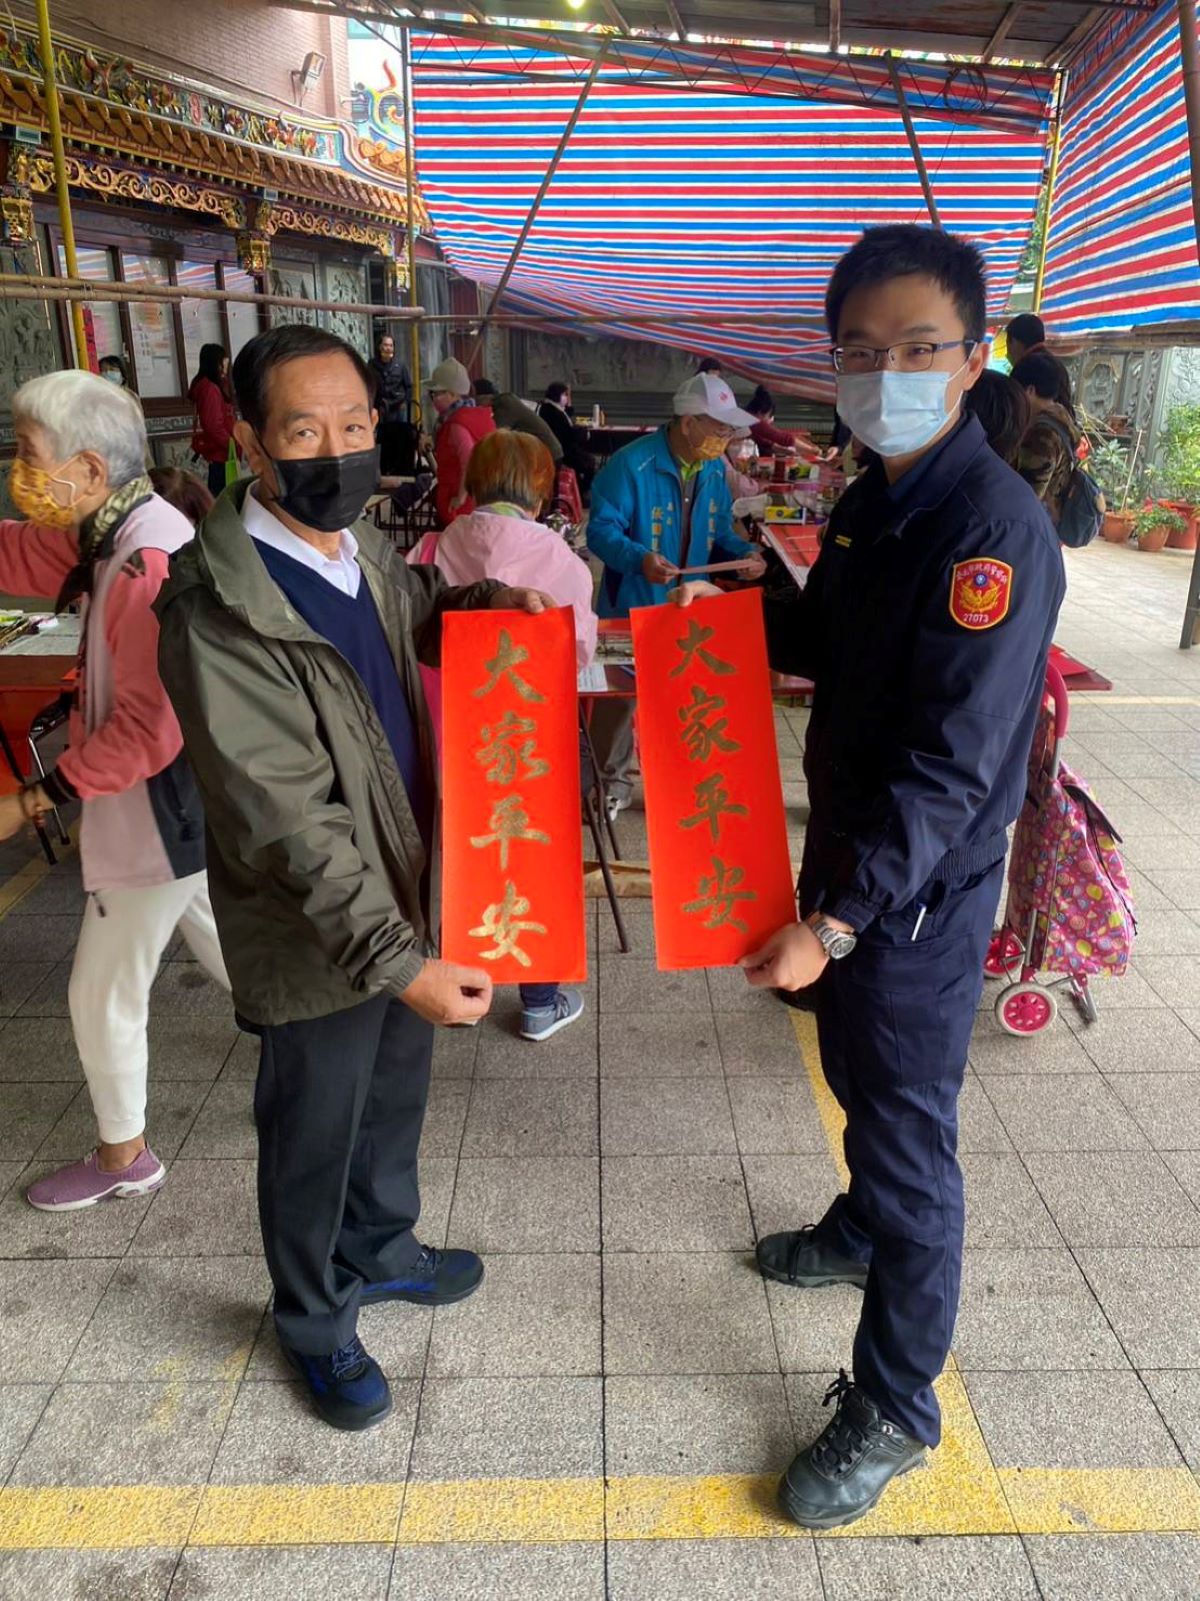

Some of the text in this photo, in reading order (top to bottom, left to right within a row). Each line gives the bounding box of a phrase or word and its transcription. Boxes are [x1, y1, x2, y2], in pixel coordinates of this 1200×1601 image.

[668, 618, 757, 934] 大家平安
[963, 613, 989, 623] 27073
[468, 628, 551, 968] 大家平安
